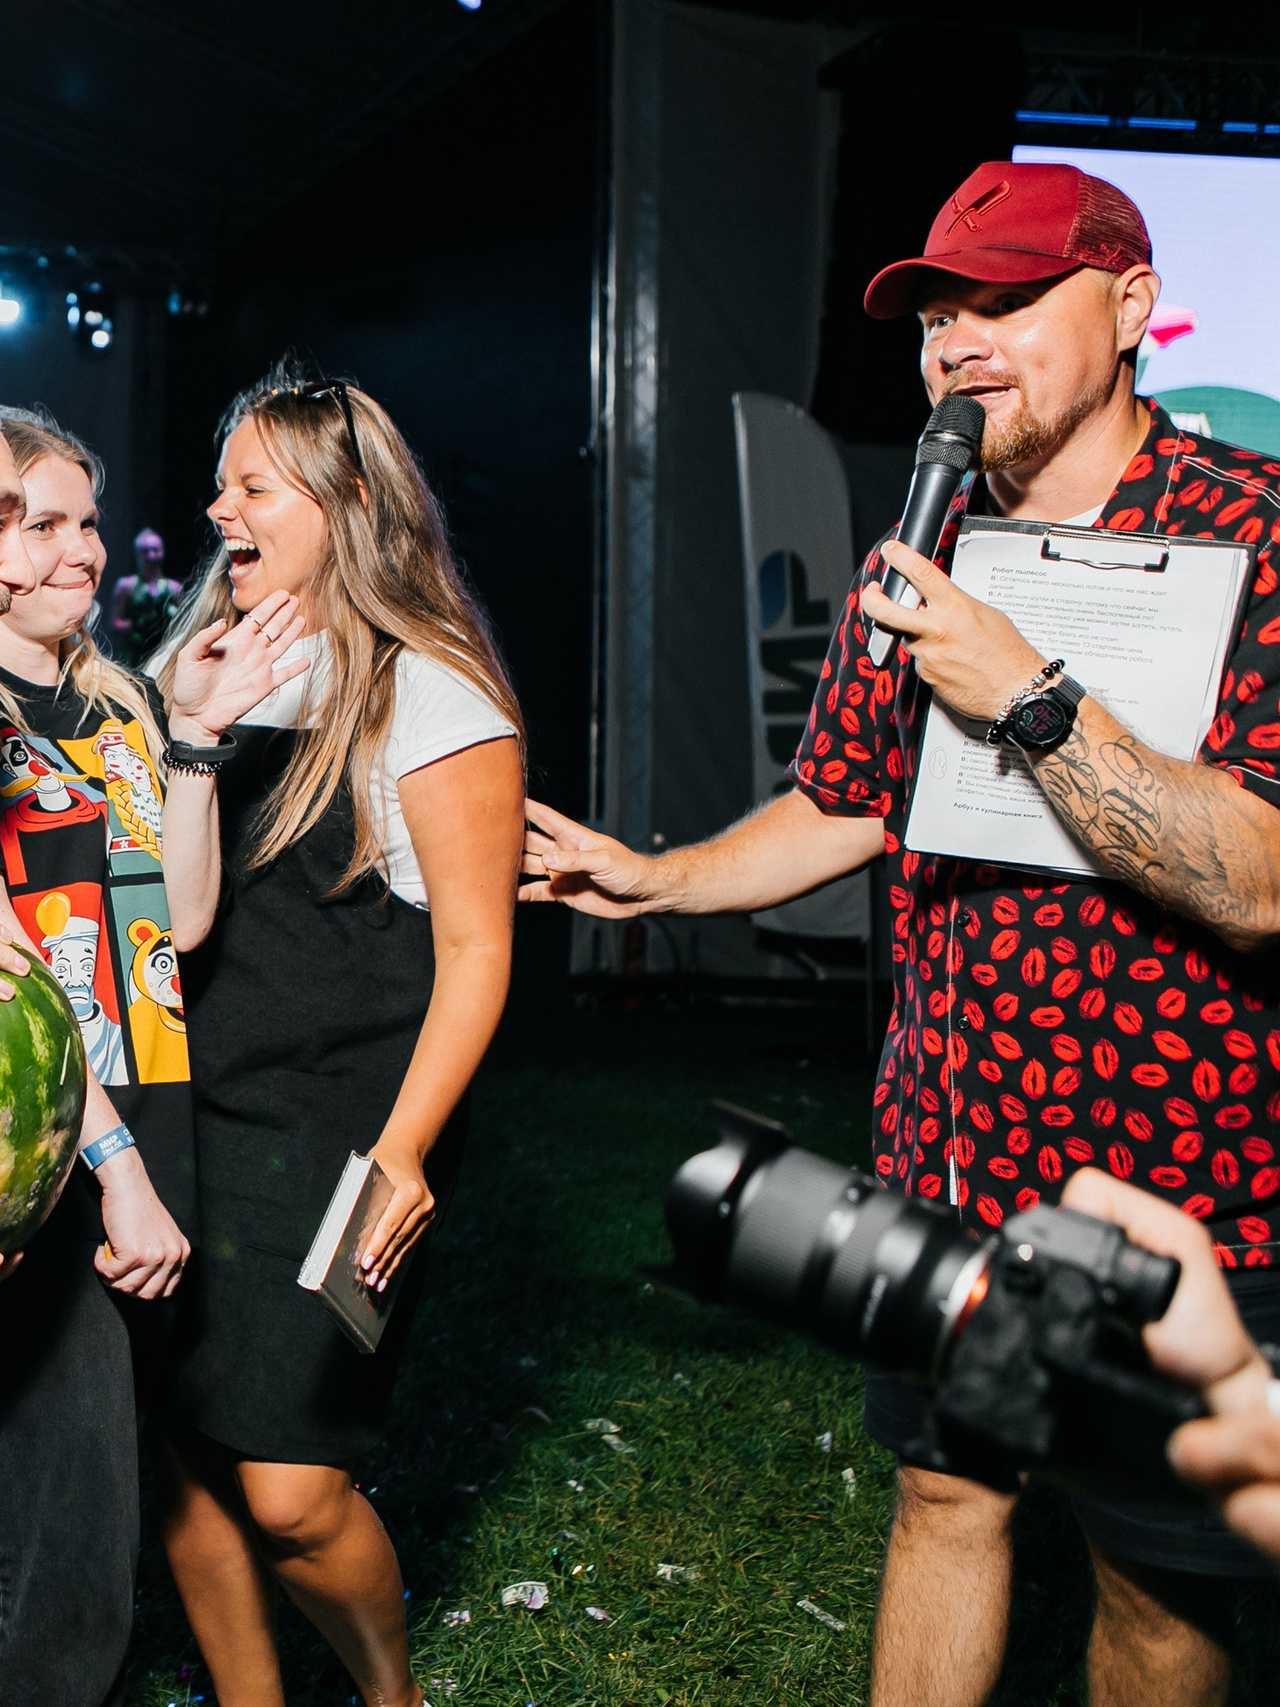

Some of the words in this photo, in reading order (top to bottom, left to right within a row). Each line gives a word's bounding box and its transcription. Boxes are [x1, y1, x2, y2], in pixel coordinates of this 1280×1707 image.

[1015, 568, 1047, 576] пылесос
[759, 550, 832, 797] ИР
[952, 801, 974, 811] Арбуз
